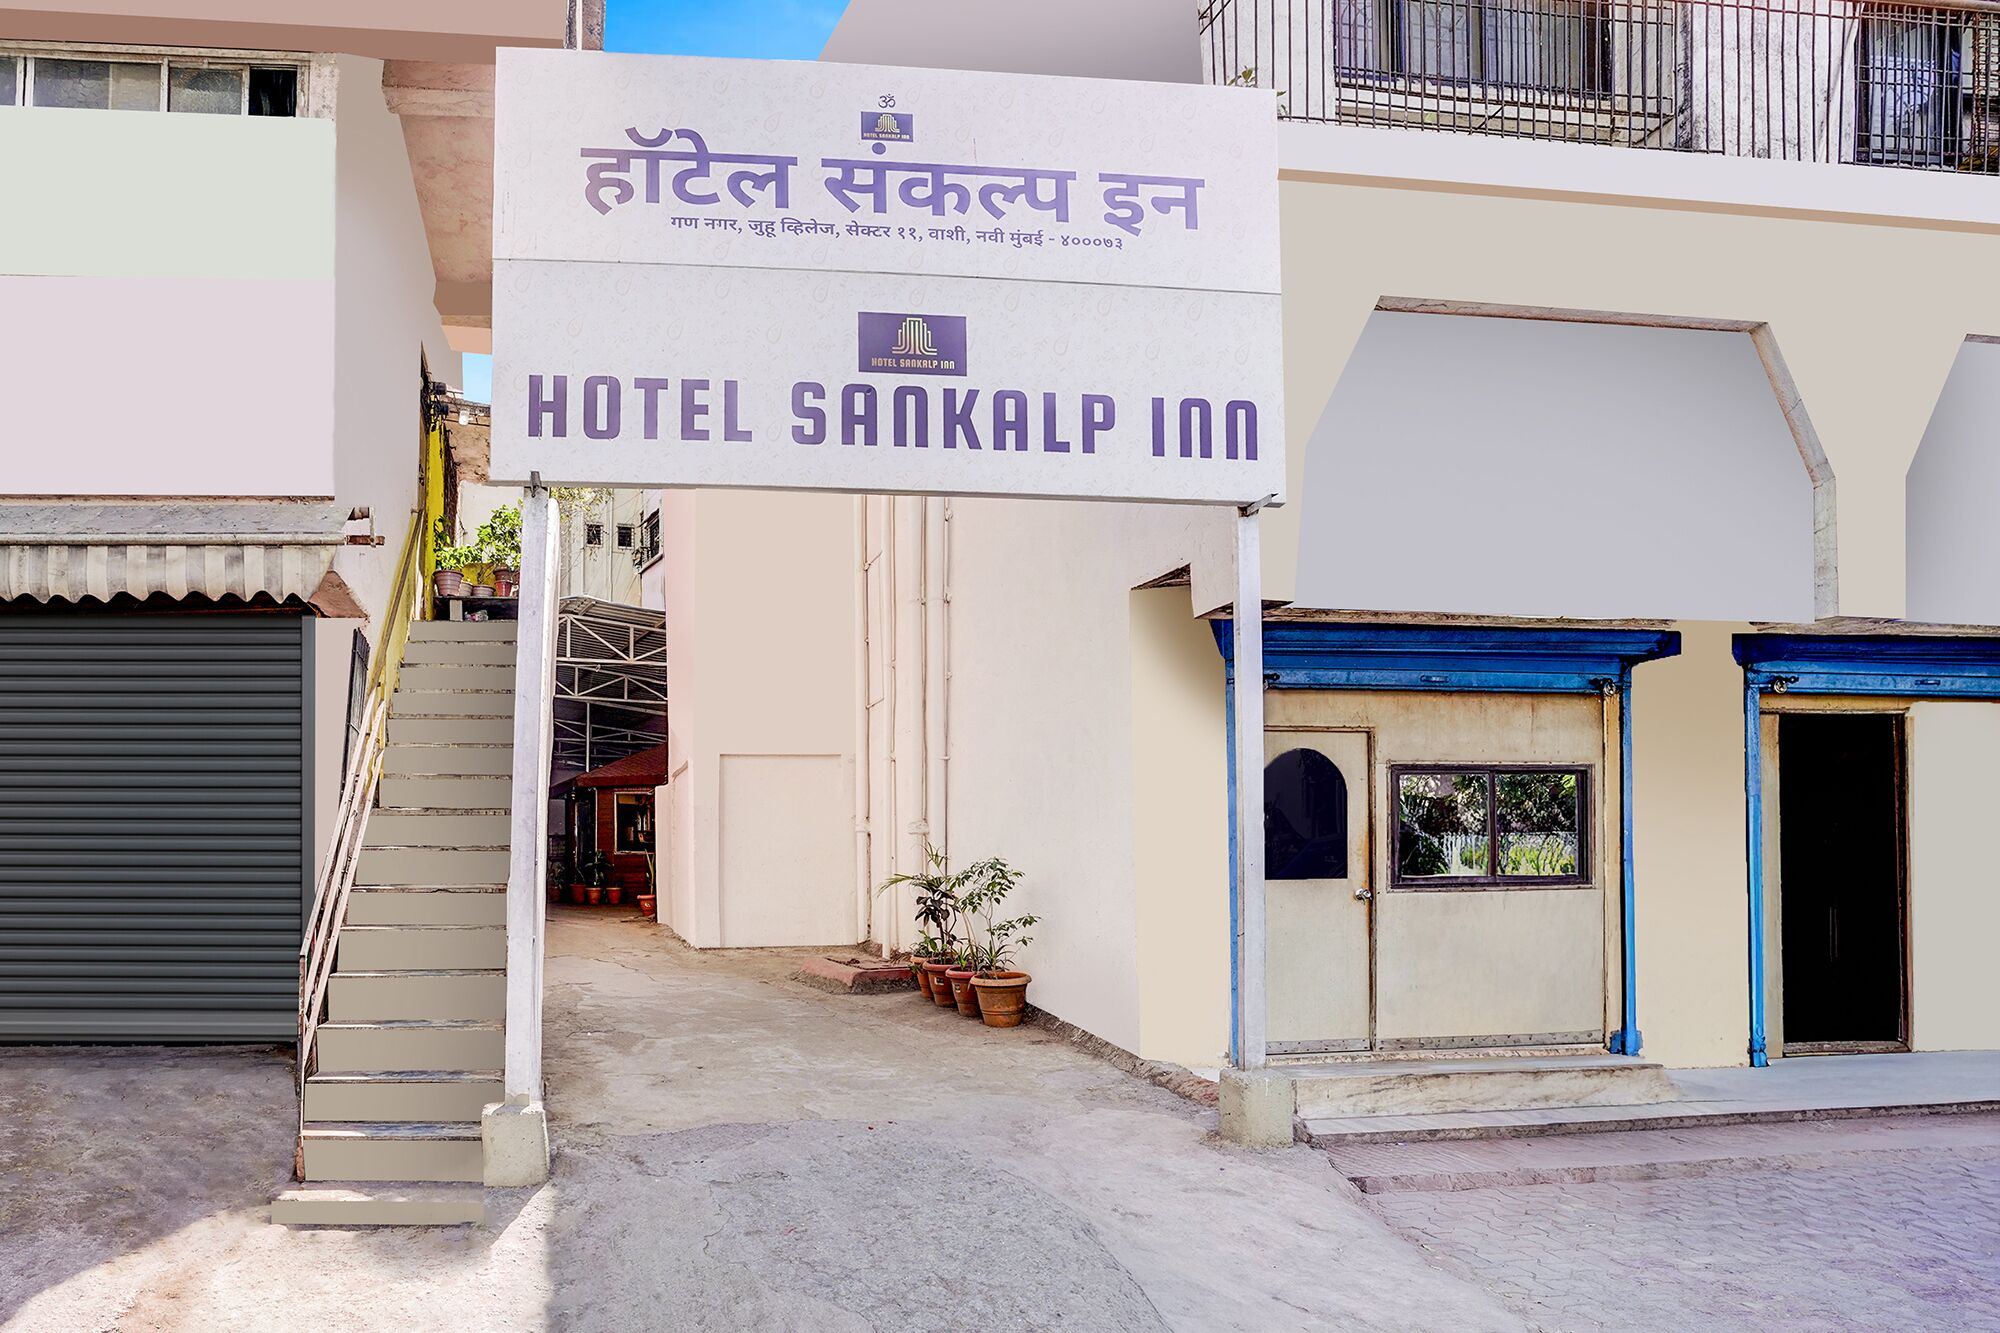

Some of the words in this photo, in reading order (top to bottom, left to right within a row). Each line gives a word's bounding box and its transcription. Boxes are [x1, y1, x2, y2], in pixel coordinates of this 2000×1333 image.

[581, 127, 798, 215] हॉटेल
[821, 142, 1076, 223] संकल्प
[1099, 173, 1205, 238] इन
[671, 216, 699, 229] गण
[704, 217, 742, 234] नगर,
[748, 219, 776, 238] जुहू
[780, 217, 840, 238] व्हिलेज,
[845, 220, 891, 237] सेक्टर
[898, 226, 922, 242] ११,
[928, 225, 970, 244] वाशी,
[976, 227, 1005, 243] नवी
[1009, 229, 1043, 248] मुंबई
[1060, 234, 1123, 250] ४०००७३
[871, 357, 897, 367] HOTEL
[528, 375, 753, 443] HOTEL
[792, 382, 1115, 454] SANKALP
[1152, 397, 1258, 461] INN
